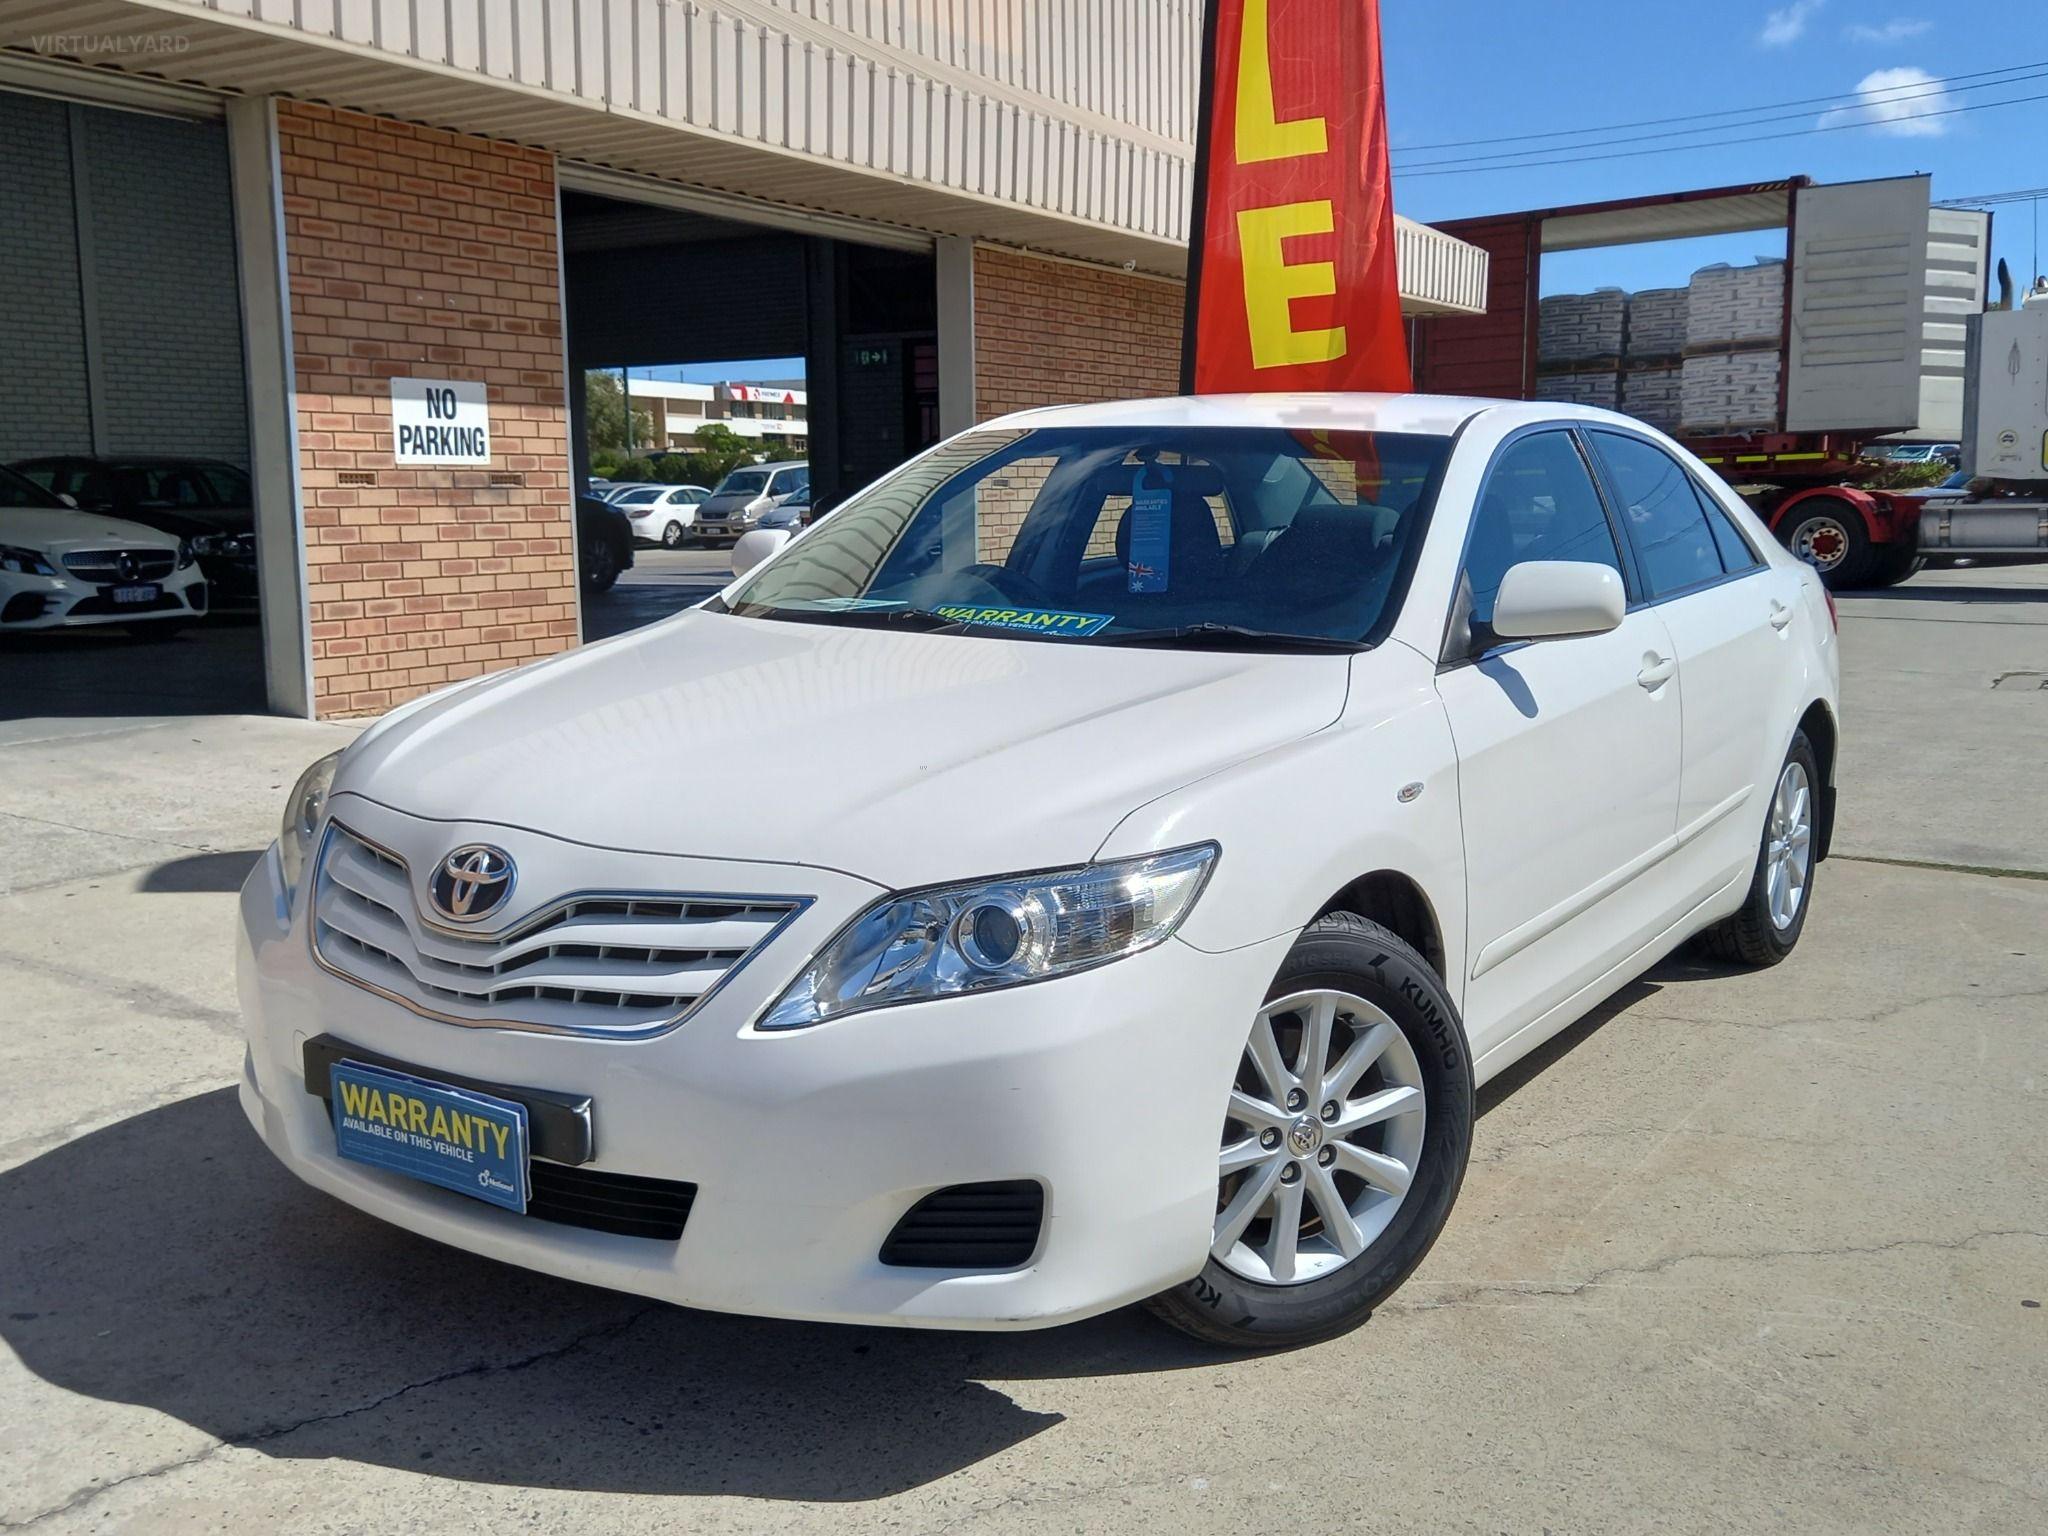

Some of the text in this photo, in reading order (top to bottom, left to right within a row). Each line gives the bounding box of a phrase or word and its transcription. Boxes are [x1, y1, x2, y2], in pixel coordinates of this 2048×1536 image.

[426, 387, 457, 419] NO
[399, 424, 486, 457] PARKING
[938, 607, 1098, 629] WARRANTY
[1007, 622, 1047, 630] VEHICLE
[1400, 975, 1459, 1071] KUMHO
[339, 1081, 510, 1160] WARRANTY
[343, 1116, 393, 1140] AVAILABLE
[394, 1130, 408, 1144] ON
[409, 1134, 432, 1150] THIS
[433, 1141, 474, 1163] VEHICLE
